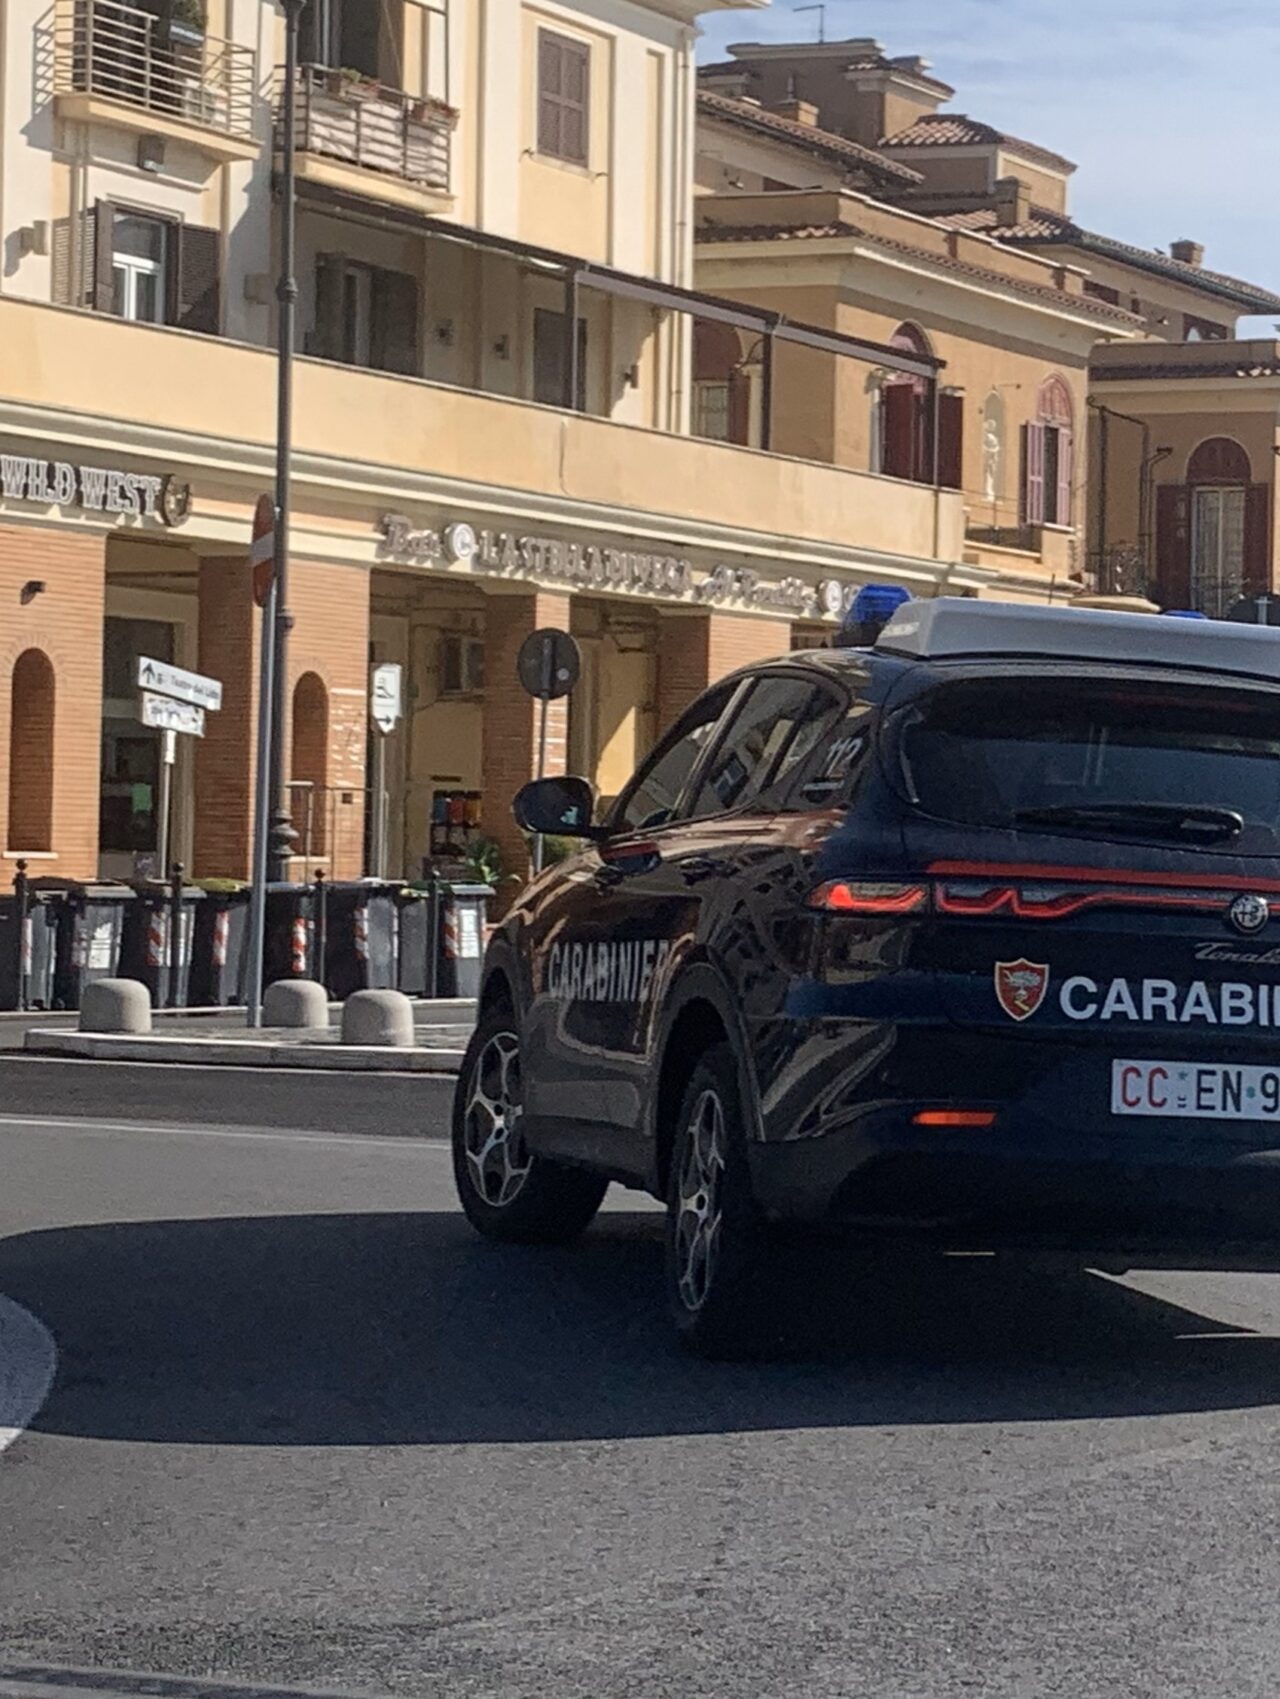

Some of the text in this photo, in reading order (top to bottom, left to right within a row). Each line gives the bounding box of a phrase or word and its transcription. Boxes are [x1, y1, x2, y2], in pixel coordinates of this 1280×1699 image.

[1, 454, 162, 518] WILD WEST
[1121, 1066, 1169, 1108] CC
[1196, 1069, 1242, 1113] EN
